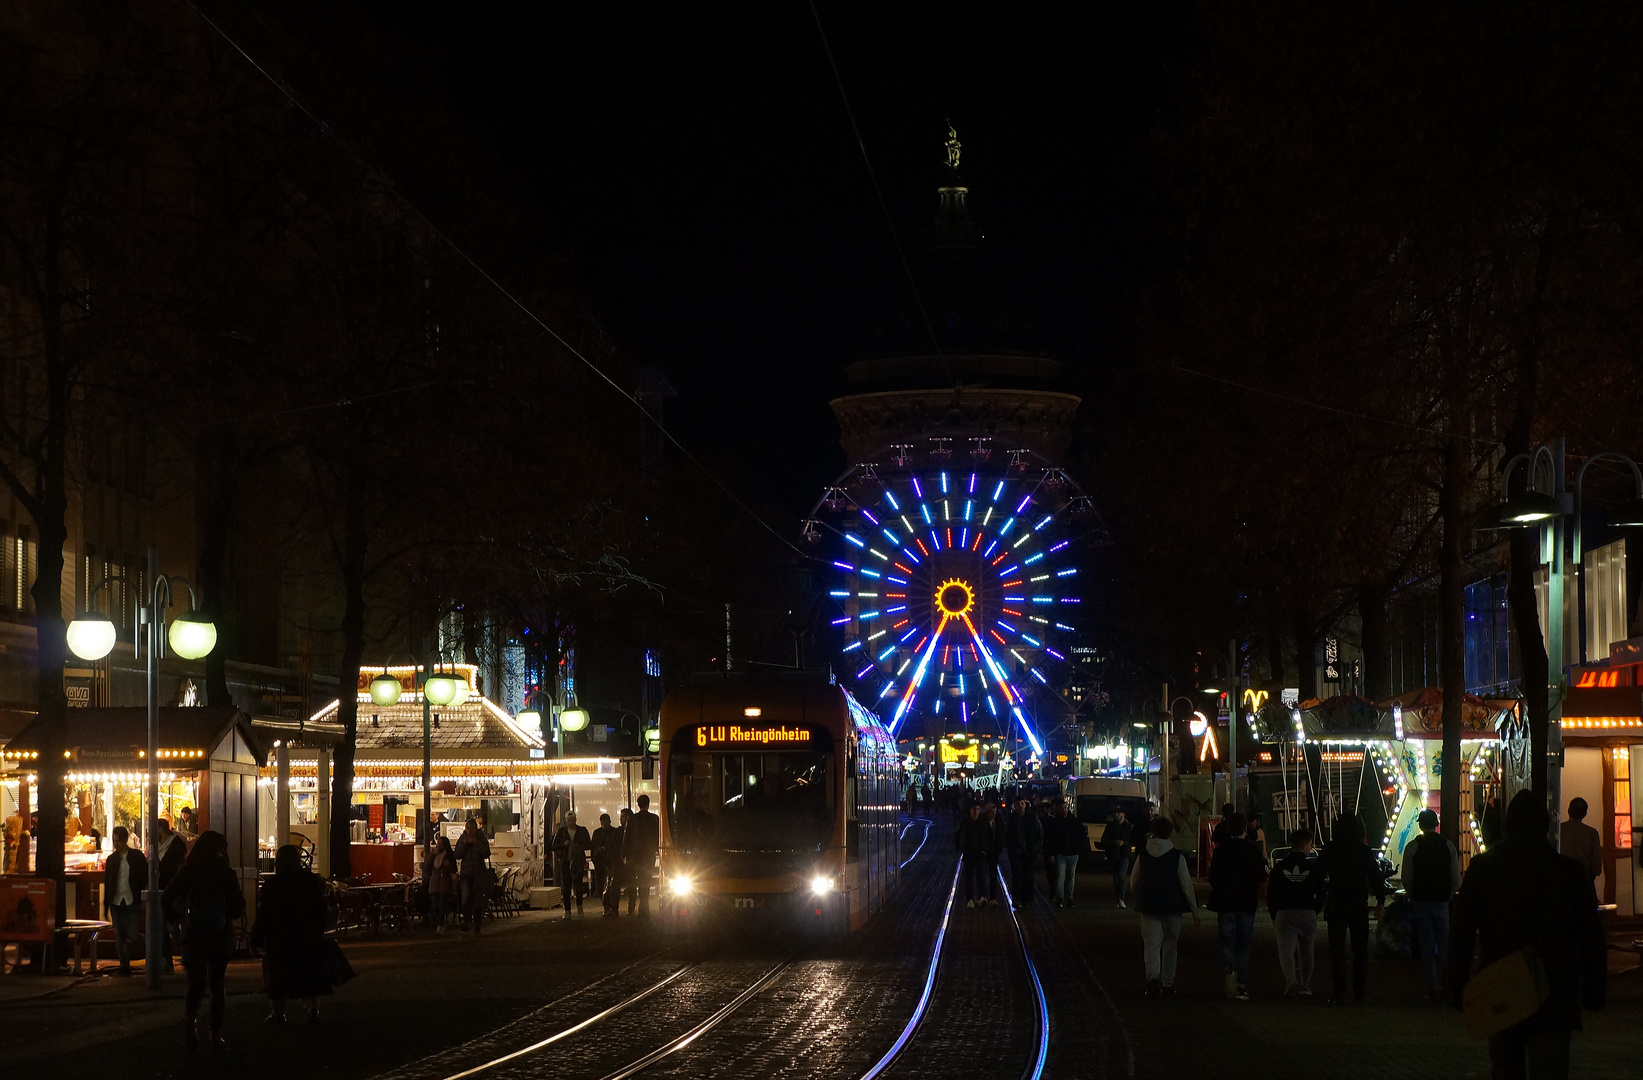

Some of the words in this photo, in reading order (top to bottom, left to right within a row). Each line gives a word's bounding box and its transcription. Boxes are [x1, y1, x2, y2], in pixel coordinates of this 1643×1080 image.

[697, 726, 707, 746] 6
[710, 726, 726, 741] LU
[730, 725, 810, 743] Rheingönheim
[372, 767, 418, 776] Weizenbier
[463, 767, 494, 775] Fanta
